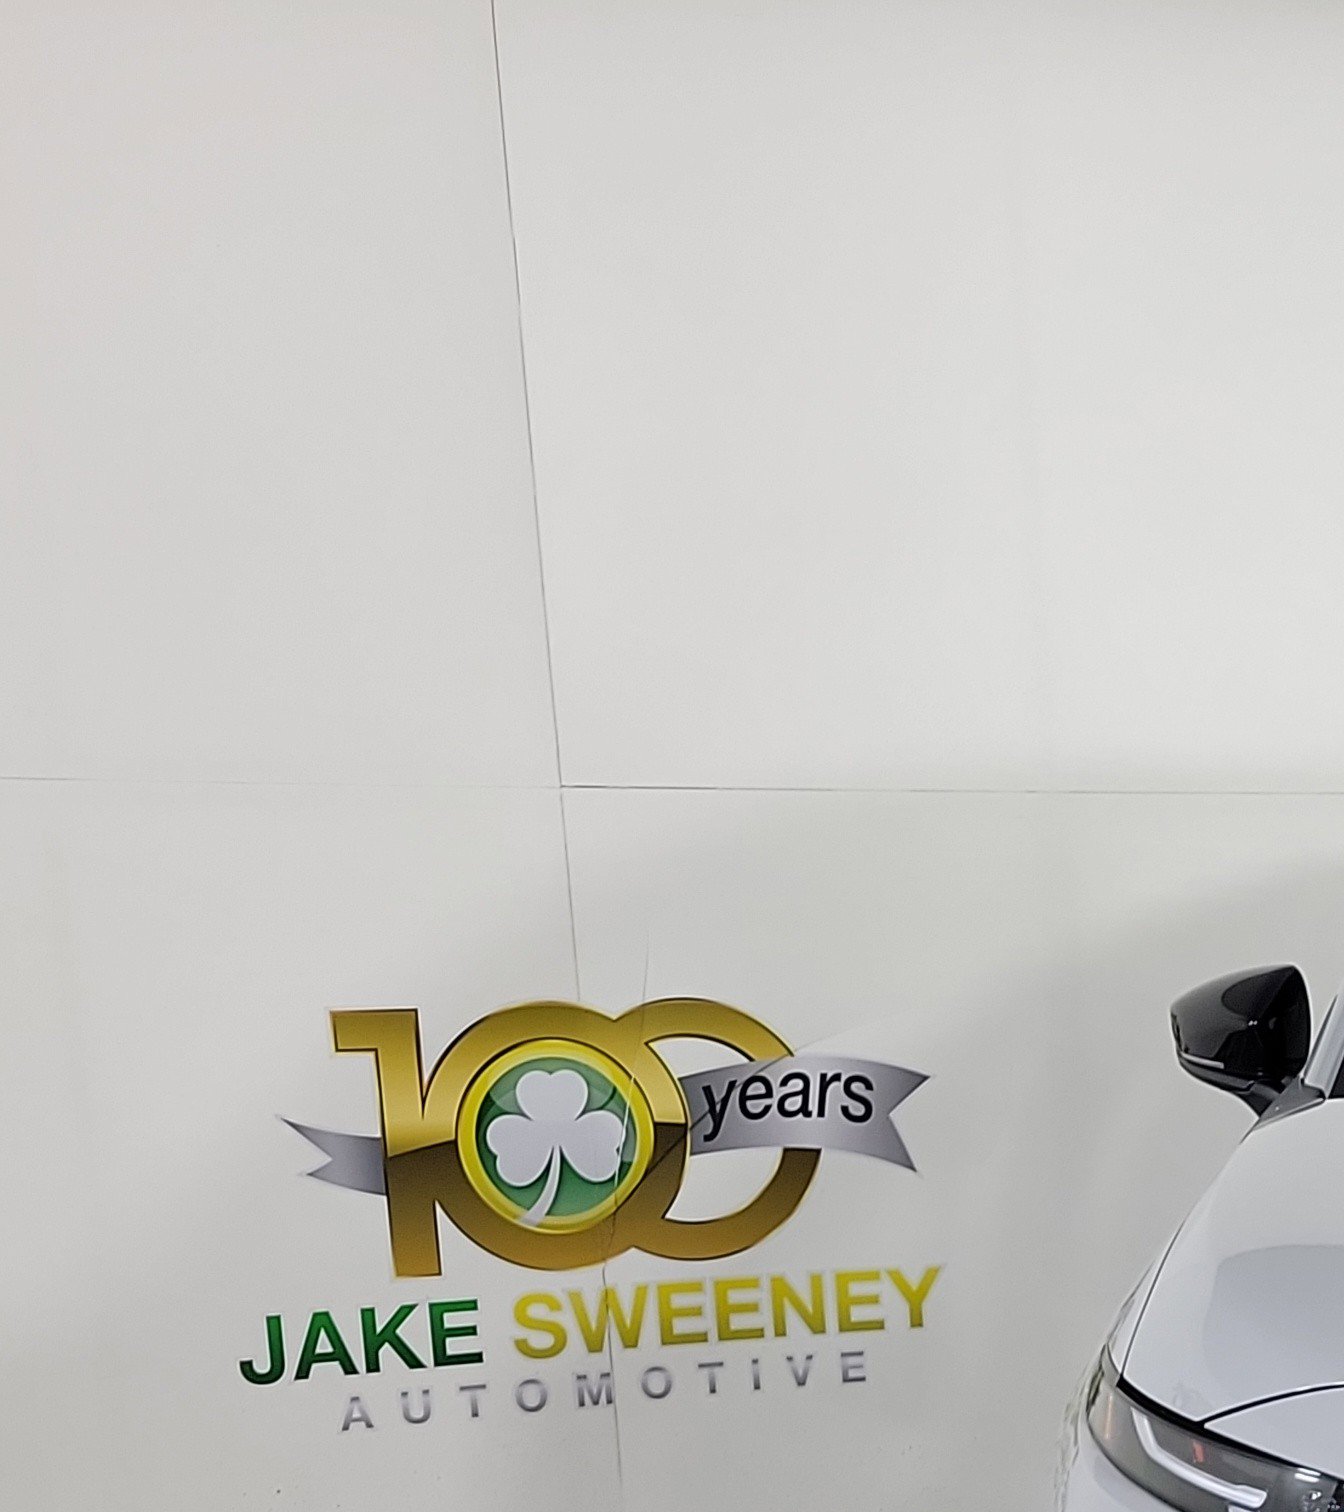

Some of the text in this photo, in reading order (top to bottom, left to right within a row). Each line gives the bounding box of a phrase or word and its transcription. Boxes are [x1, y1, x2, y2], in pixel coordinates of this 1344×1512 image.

[330, 997, 875, 1278] 100 years
[239, 1265, 945, 1386] JAKE SWEENEY
[340, 1349, 868, 1433] AUTOMOTIVE
